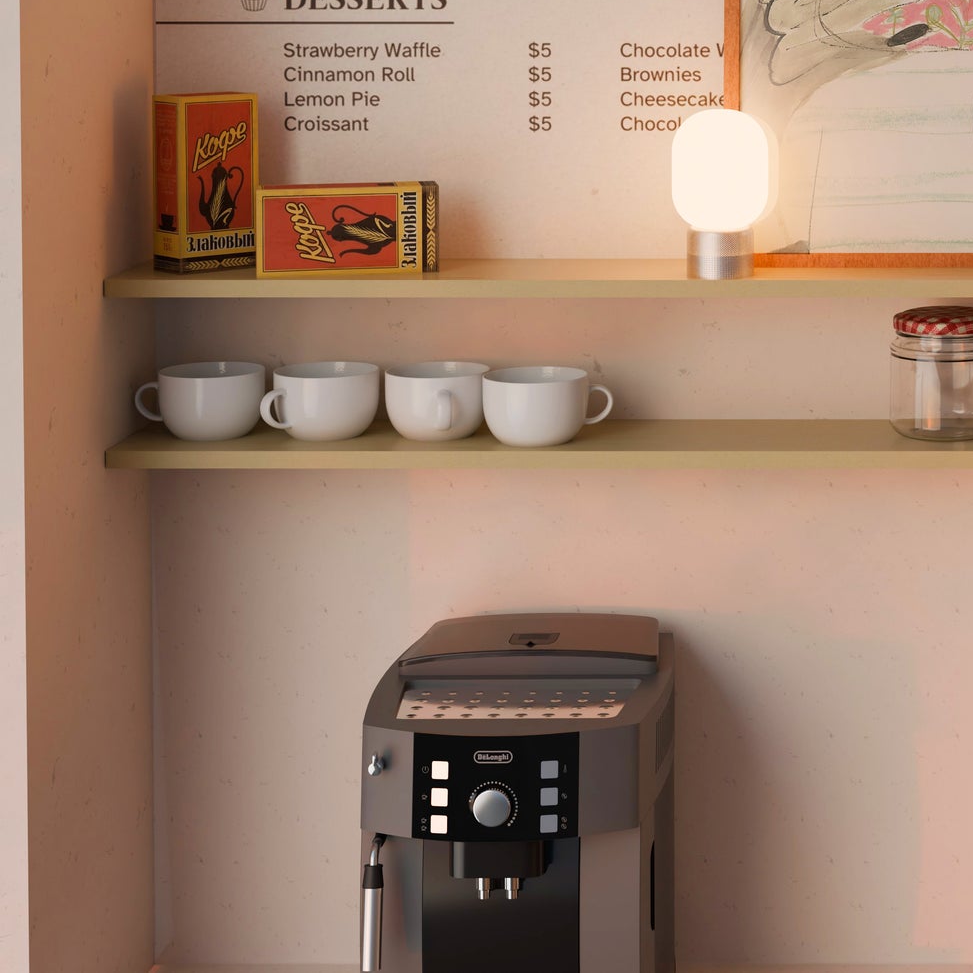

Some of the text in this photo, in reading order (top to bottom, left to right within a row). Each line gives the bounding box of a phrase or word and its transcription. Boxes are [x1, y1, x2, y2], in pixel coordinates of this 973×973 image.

[284, 42, 440, 60] Strawberry Waffle
[529, 42, 551, 58] $5
[620, 43, 710, 57] Chocolate
[284, 66, 415, 82] Cinnamon Roll
[529, 66, 551, 82] $5
[621, 67, 701, 81] Brownies
[284, 91, 382, 106] Lemon Pie
[529, 91, 551, 107] $5
[284, 115, 368, 131] Croissant
[529, 116, 551, 132] $5
[192, 121, 247, 173] Кофе
[285, 202, 336, 264] Кофе
[400, 191, 417, 269] Злаковый
[186, 230, 255, 253] Злаковый
